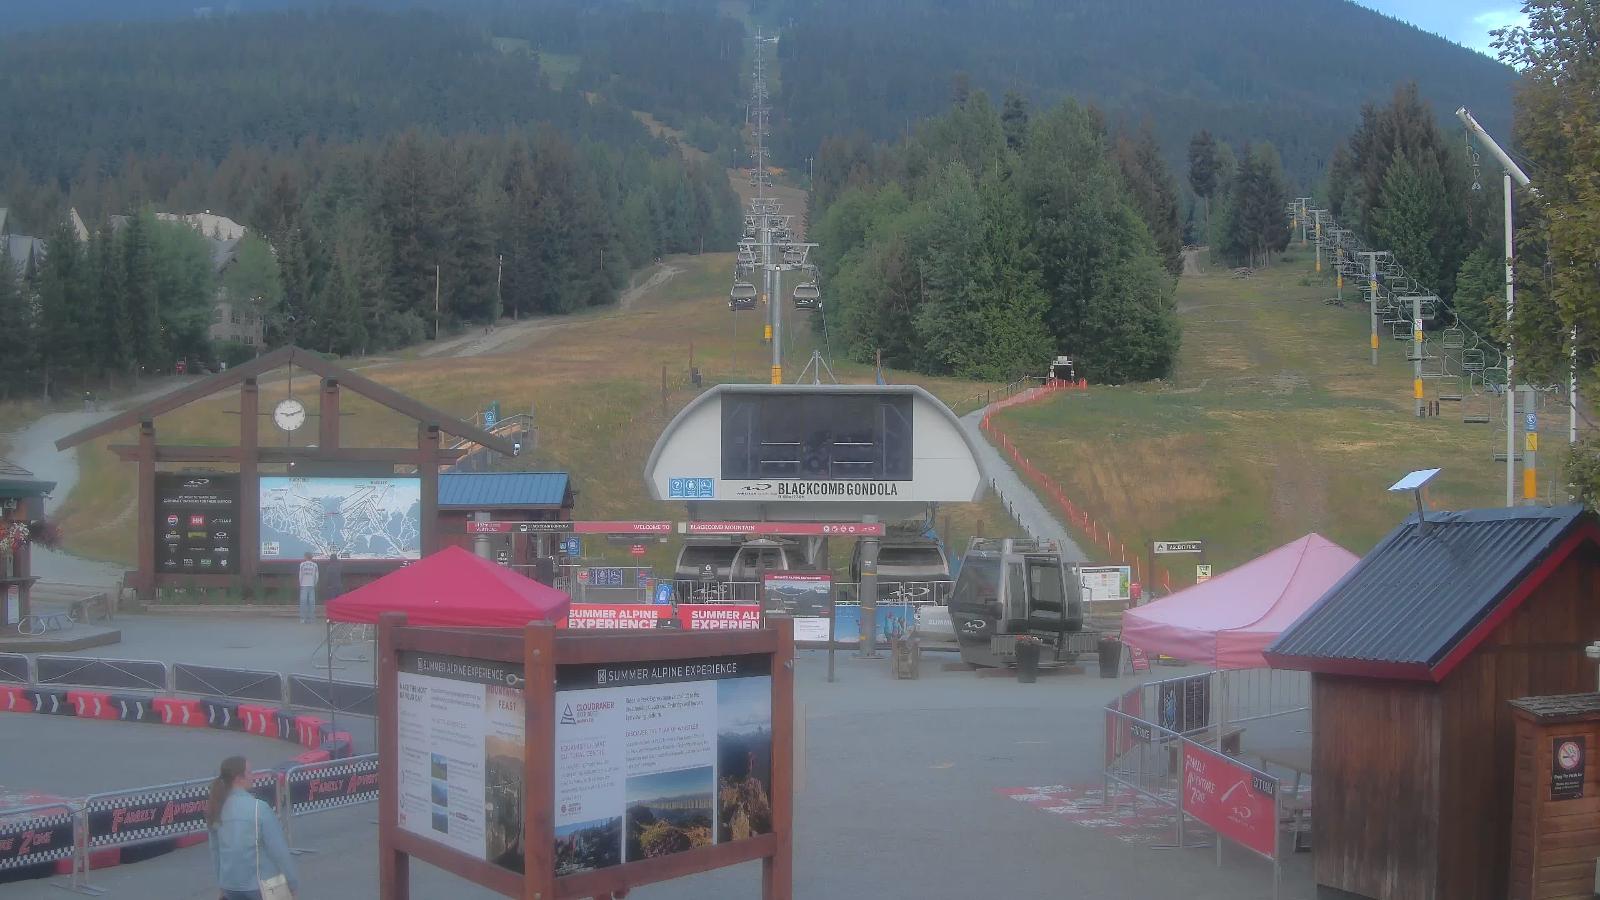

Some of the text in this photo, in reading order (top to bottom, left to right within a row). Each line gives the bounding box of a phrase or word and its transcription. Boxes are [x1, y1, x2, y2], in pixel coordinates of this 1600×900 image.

[778, 482, 898, 496] BLACKCOMB GONDOLA
[569, 609, 658, 619] SUMMER ALPINE
[691, 610, 740, 619] SUMMER
[568, 619, 657, 629] EXPERIENCE
[423, 660, 446, 673] SUMMER
[467, 666, 504, 681] EXPERIENCE
[608, 662, 737, 681] SUMMER ALPINE EXPERIENCE
[498, 700, 516, 711] FEAST
[576, 701, 615, 711] CLOUDRAKER
[309, 779, 343, 800] FAMILY
[111, 808, 157, 833] FAMILY
[19, 831, 53, 854] ZONE
